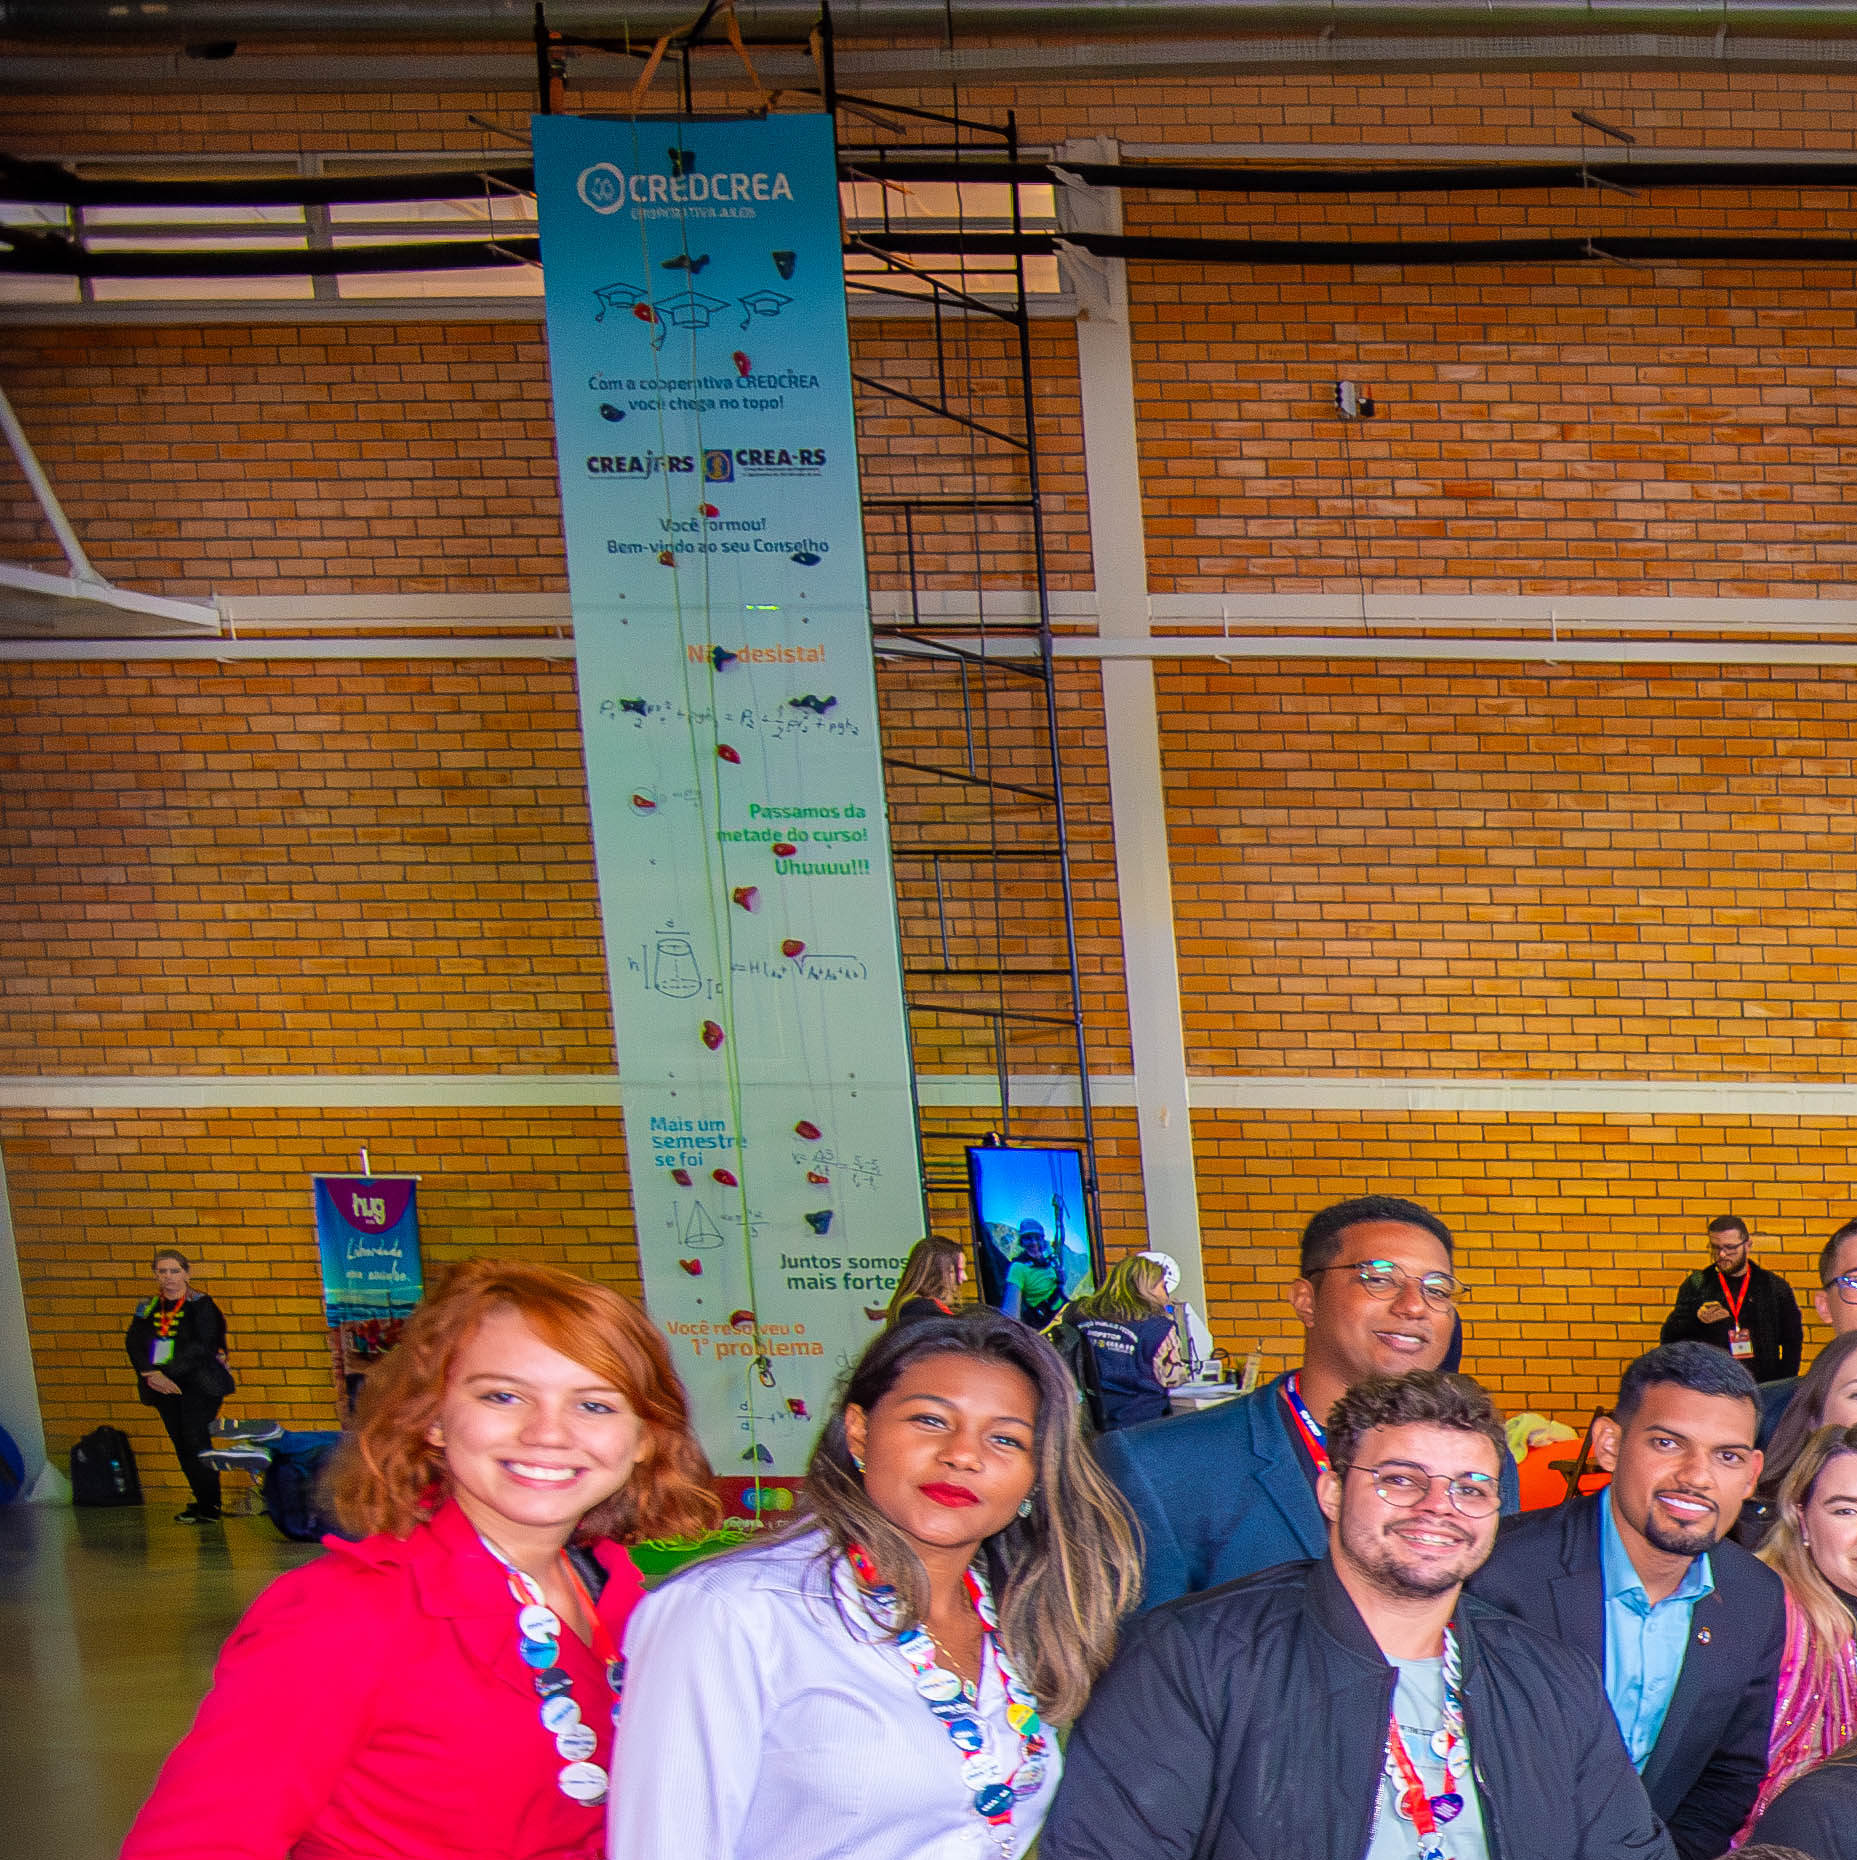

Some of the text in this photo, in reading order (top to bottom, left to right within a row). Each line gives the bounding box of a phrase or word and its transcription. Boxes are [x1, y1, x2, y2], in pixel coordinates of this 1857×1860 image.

[629, 172, 794, 203] CREDCREA
[588, 376, 624, 391] Com
[626, 379, 636, 391] a
[736, 373, 820, 390] CREDCREA
[719, 399, 740, 411] no
[743, 395, 784, 412] topo!
[736, 448, 827, 467] CREA-RS
[659, 516, 699, 532] Você
[607, 537, 830, 554] Bem-vindo ao seu Conselho
[738, 642, 826, 664] desista!
[750, 803, 867, 820] Passamos da
[717, 827, 868, 843] metade do curso!
[650, 1116, 726, 1132] Mais um
[652, 1135, 748, 1150] semestre
[655, 1151, 704, 1167] se foi
[352, 1192, 387, 1225] hug
[779, 1253, 909, 1271] Juntos somos
[787, 1273, 903, 1290] mais forte
[666, 1319, 710, 1336] Você
[793, 1322, 806, 1335] o
